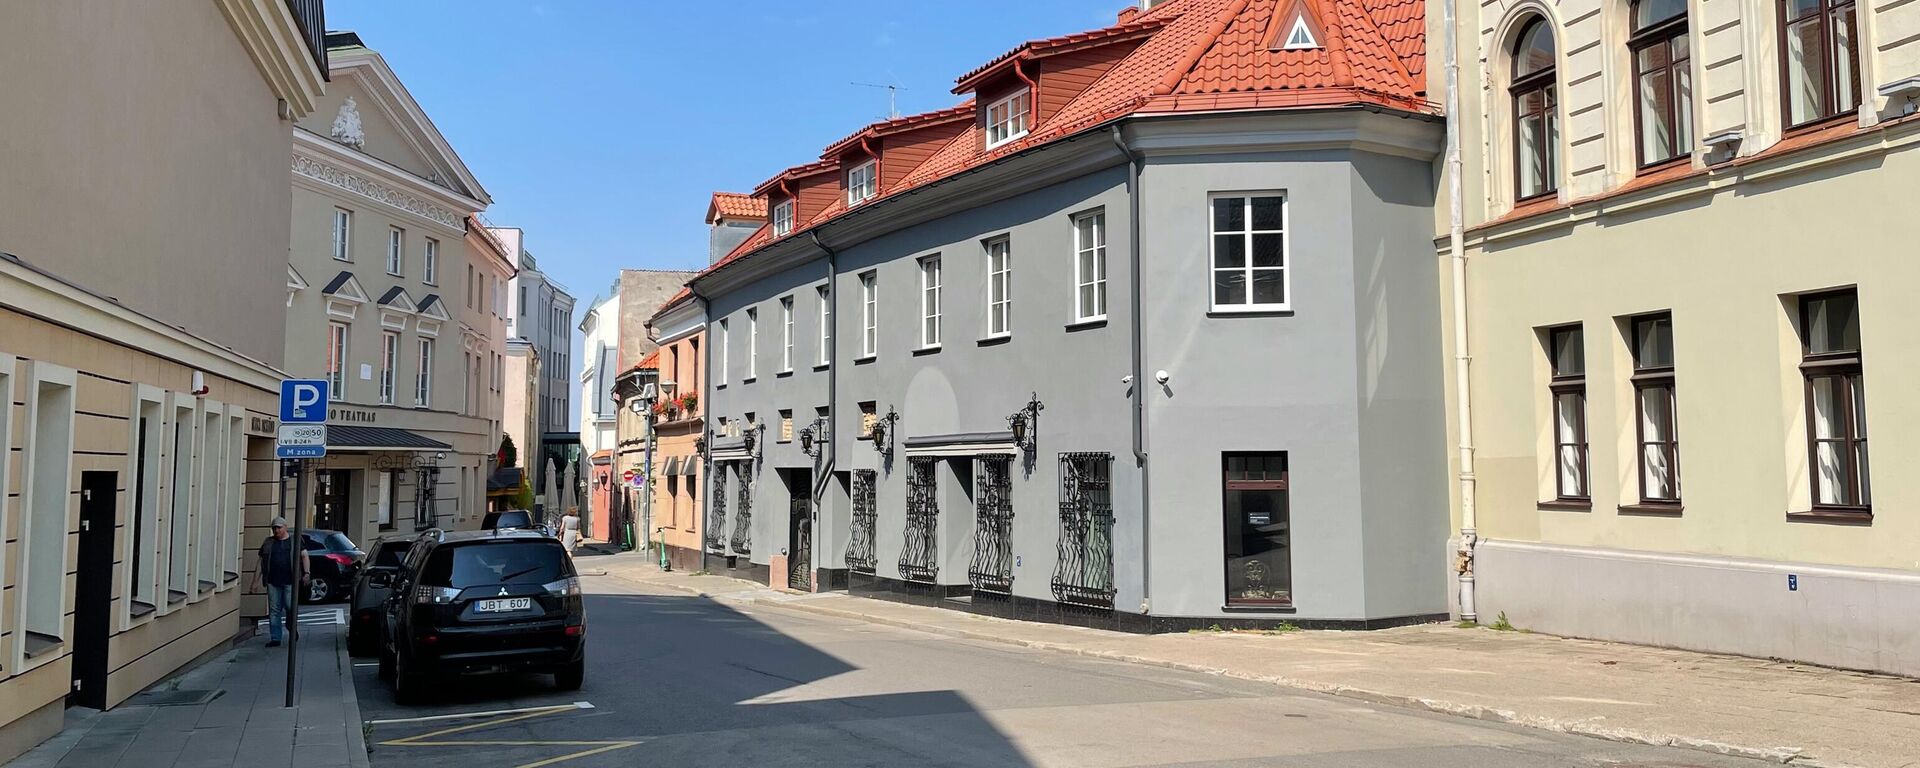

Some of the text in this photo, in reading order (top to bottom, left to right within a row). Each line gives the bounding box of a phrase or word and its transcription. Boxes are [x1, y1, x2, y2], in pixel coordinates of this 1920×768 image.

[293, 384, 319, 418] P
[340, 409, 376, 422] TEATRAS
[481, 598, 529, 610] JBT 607
